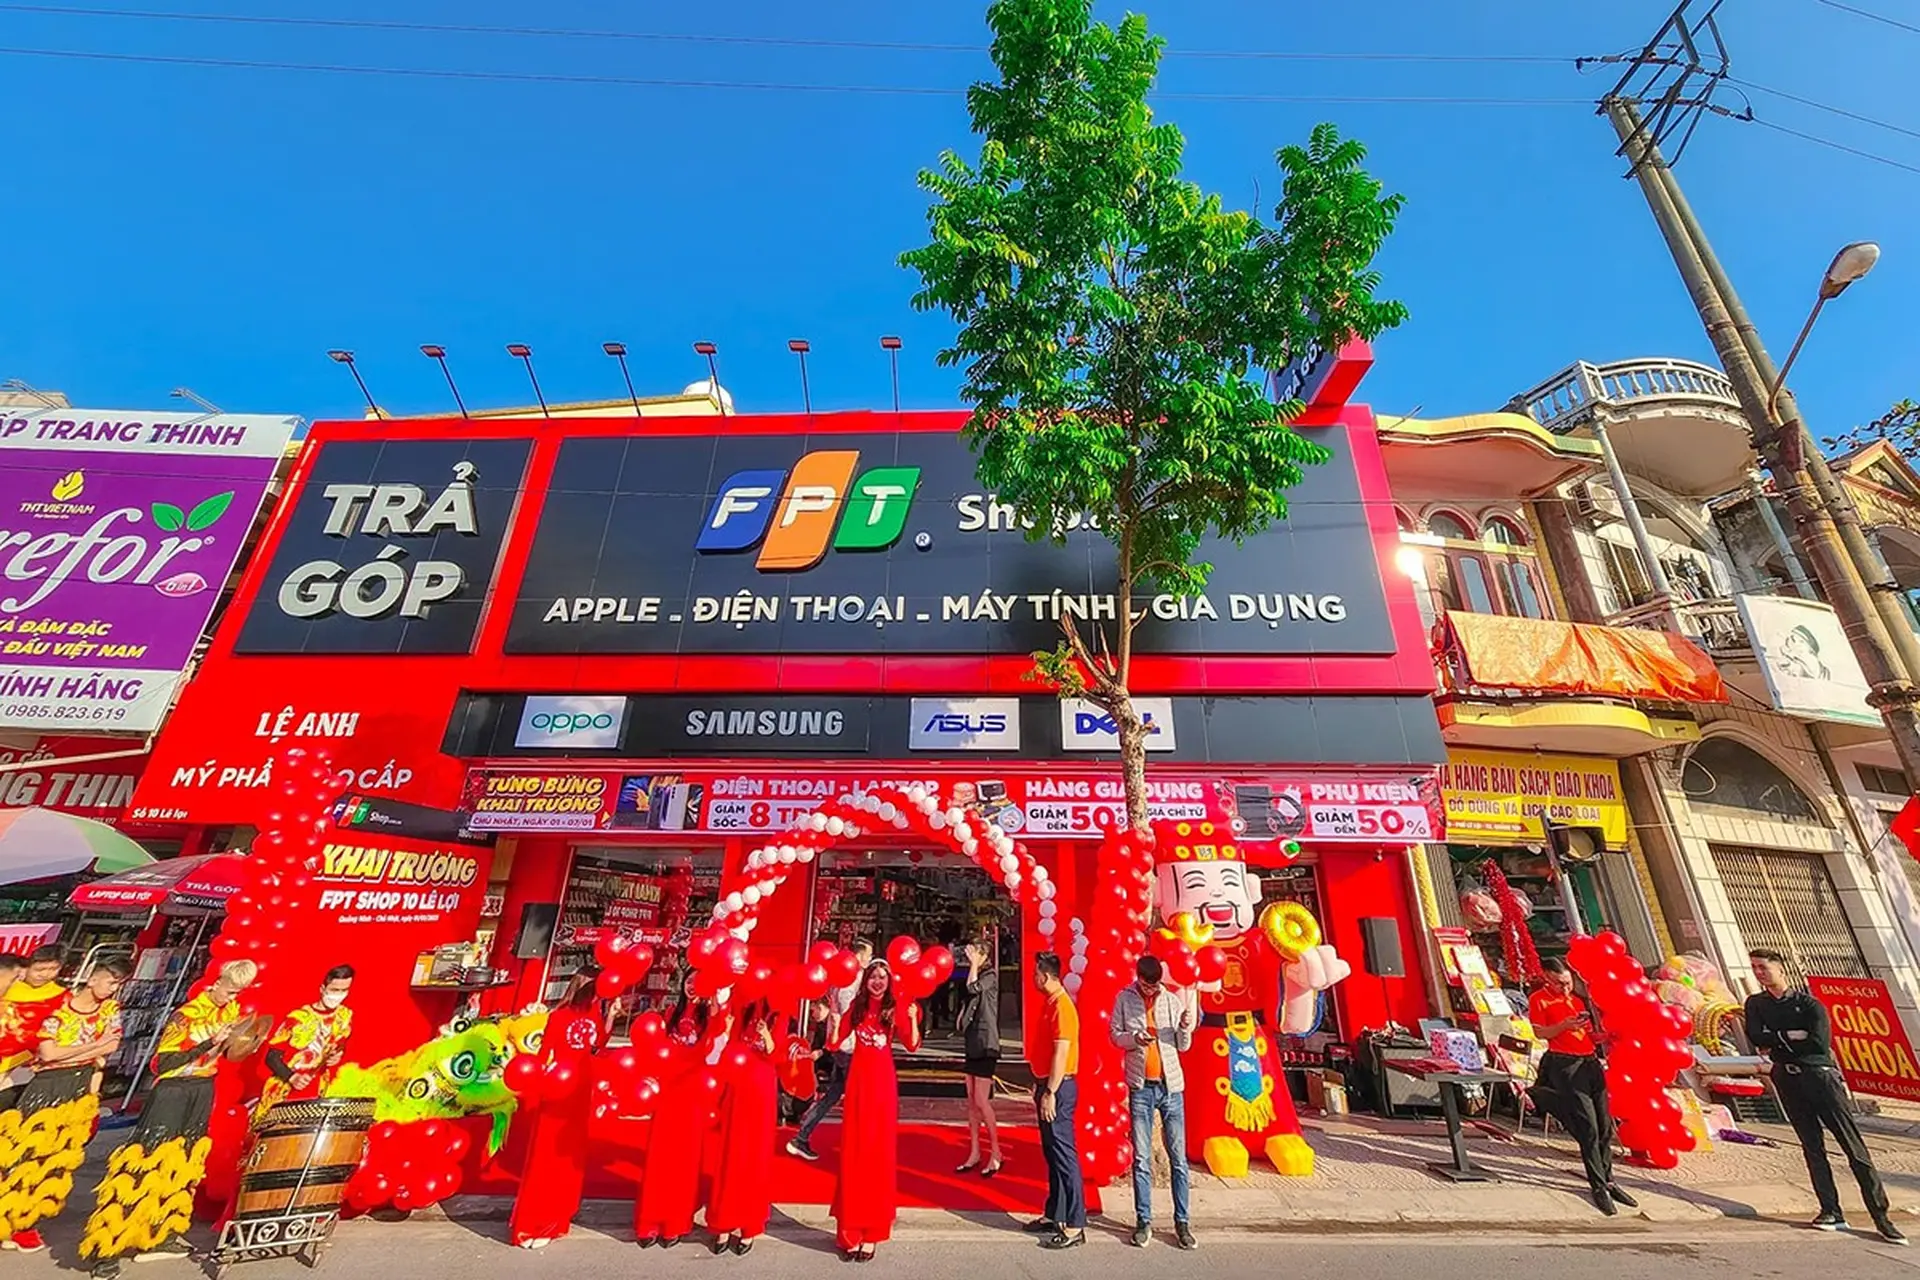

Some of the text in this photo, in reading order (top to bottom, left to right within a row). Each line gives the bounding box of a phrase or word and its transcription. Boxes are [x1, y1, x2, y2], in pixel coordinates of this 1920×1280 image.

[36, 420, 143, 442] TRANG
[149, 423, 247, 446] THINH
[323, 461, 480, 537] TRẢ
[278, 544, 467, 619] GÓP
[544, 597, 660, 622] APPLE
[693, 589, 778, 629] ĐIỆN
[790, 595, 904, 627] THOẠI
[943, 588, 1017, 622] MÁY
[1027, 588, 1115, 622] TÍNH
[1153, 594, 1218, 622] GIA
[1230, 595, 1347, 628] DỤNG
[97, 645, 147, 658] NAM
[0, 669, 143, 700] ÍNH HÃNG
[5, 705, 125, 720] 0985.823.619
[255, 706, 360, 743] LỆ ANH
[531, 713, 612, 733] oppo
[686, 711, 843, 735] SAMSUNG
[924, 714, 1005, 733] ASUS
[1075, 712, 1160, 735] DEL
[217, 757, 274, 787] PHẨ
[358, 759, 413, 789] CẤP
[1455, 760, 1489, 792] HÀNG
[1584, 773, 1616, 800] KHOA
[43, 772, 135, 808] THIN
[712, 776, 763, 799] ĐIỆN
[769, 779, 835, 799] THOẠI
[1026, 778, 1090, 797] HÀNG
[1311, 780, 1419, 806] PHỤ KIỆN
[476, 799, 520, 812] KHAI
[749, 803, 770, 827] 8
[1315, 811, 1354, 824] GIẢM
[319, 890, 356, 909] FPT
[355, 891, 401, 910] SHOP
[402, 892, 418, 910] 10
[419, 890, 437, 910] LÊ
[1831, 999, 1890, 1037] GIÁO
[1834, 1036, 1920, 1081] KHOA
